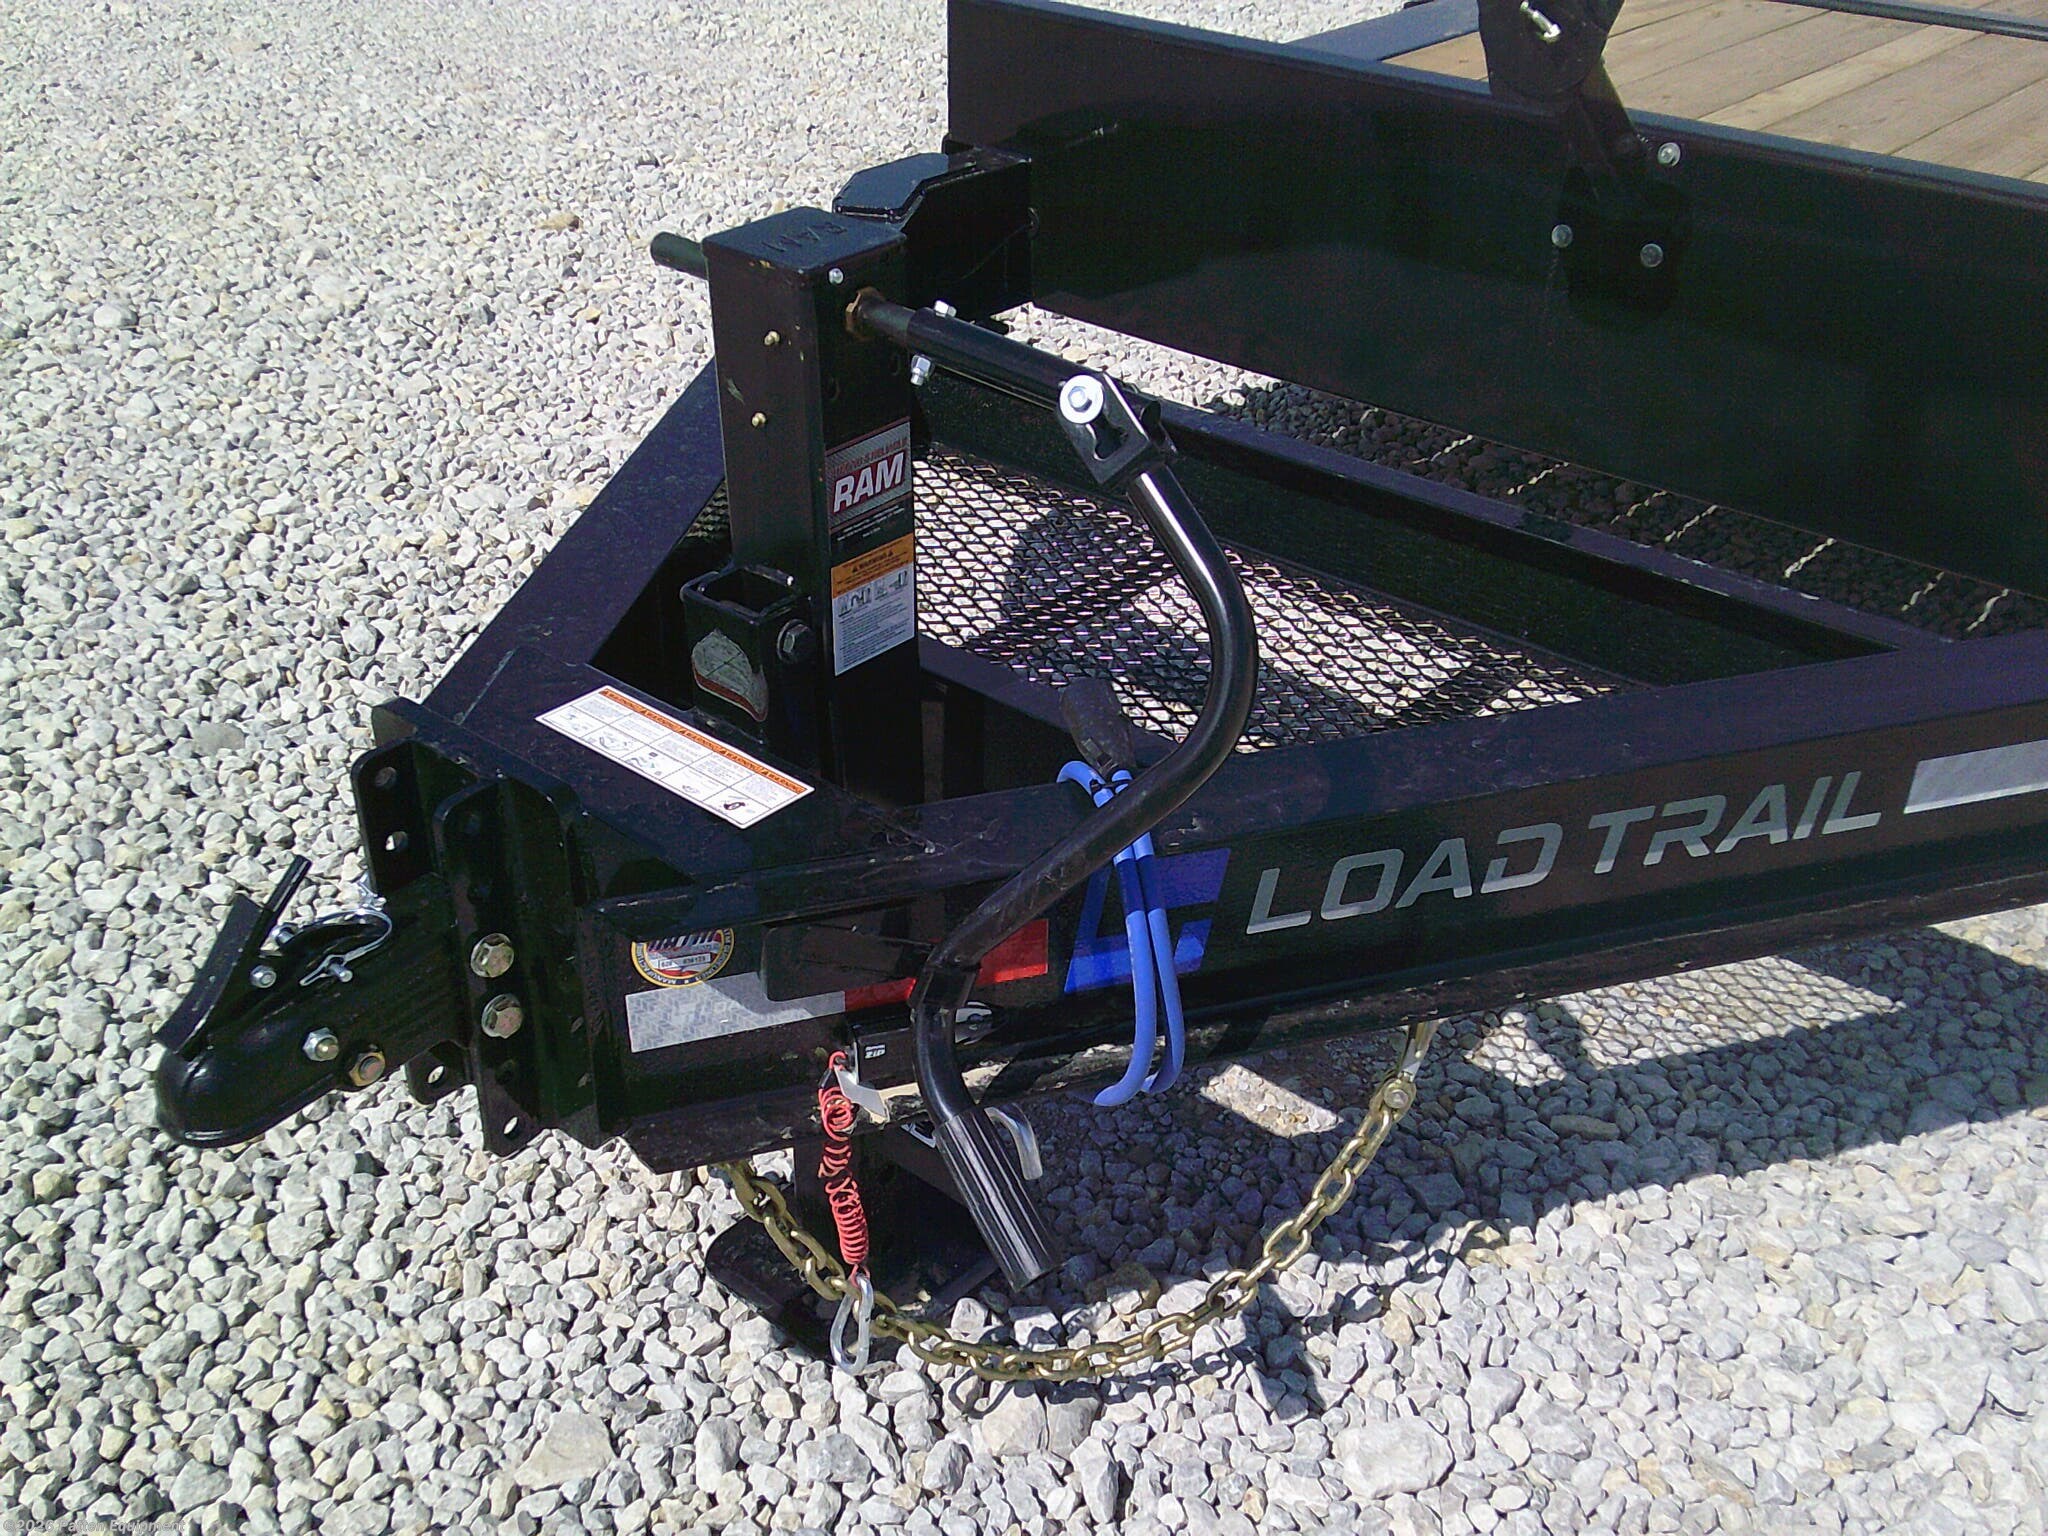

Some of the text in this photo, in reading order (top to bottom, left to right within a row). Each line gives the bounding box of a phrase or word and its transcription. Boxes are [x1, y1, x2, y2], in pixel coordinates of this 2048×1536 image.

[833, 452, 905, 513] RAM
[1246, 771, 1882, 934] LOAD TRAIL
